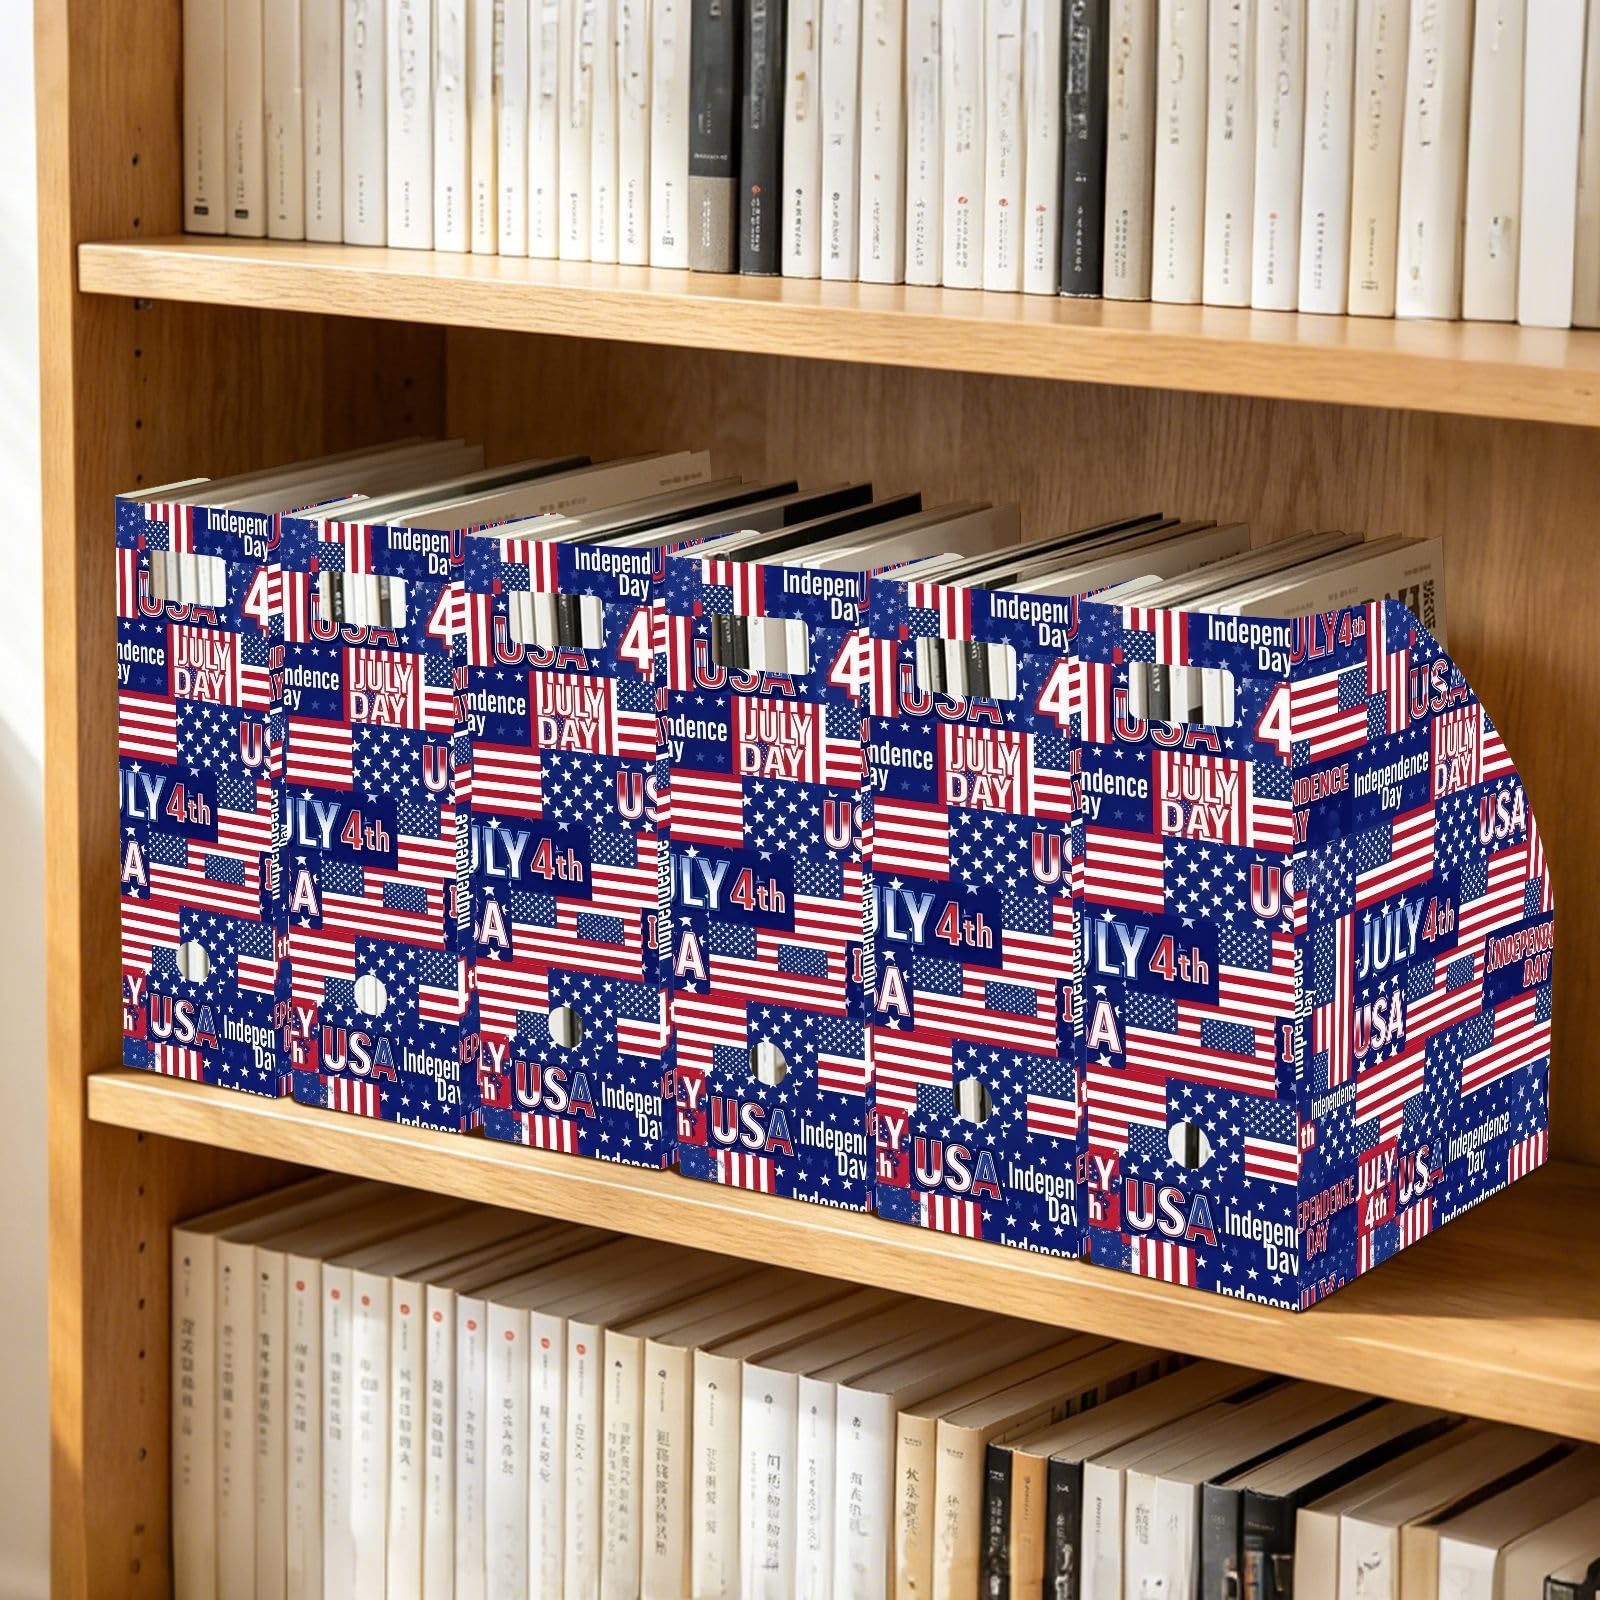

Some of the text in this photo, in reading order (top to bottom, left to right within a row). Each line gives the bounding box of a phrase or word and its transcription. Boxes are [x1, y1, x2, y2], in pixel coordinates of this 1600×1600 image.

[1339, 612, 1366, 648] 4th
[178, 636, 230, 671] JULY
[175, 669, 226, 702] DAY
[354, 657, 412, 696] JULY
[1409, 658, 1468, 720] USA
[351, 691, 406, 723] DAY
[542, 682, 603, 721] JULY
[538, 716, 598, 749] DAY
[745, 709, 811, 750] JULY
[1438, 716, 1476, 760] JULY
[740, 742, 804, 778] DAY
[951, 736, 1020, 776] JULY
[1354, 751, 1429, 798] Independence
[1434, 756, 1473, 792] DAY
[120, 769, 210, 825] LY 4th
[946, 770, 1013, 807] DAY
[1167, 764, 1238, 805] JULY
[1381, 784, 1402, 811] Day
[341, 810, 390, 852] 4th
[1162, 799, 1233, 839] DAY
[1479, 786, 1527, 845] USA
[531, 838, 583, 882] 4th
[730, 868, 785, 913] 4th
[935, 901, 992, 950] 4th
[1357, 896, 1454, 982] JULY 4th
[1149, 934, 1209, 985] 4th
[1523, 951, 1552, 988] DAY
[151, 993, 218, 1049] USA
[1354, 990, 1404, 1058] USA
[323, 1024, 397, 1082] USA
[515, 1060, 596, 1119] USA
[1311, 1082, 1356, 1120] Independence
[711, 1096, 794, 1157] USA
[1449, 1112, 1510, 1163] Independence
[914, 1137, 1002, 1200] USA
[1356, 1150, 1395, 1202] JULY
[1398, 1138, 1444, 1204] USA
[1125, 1177, 1217, 1247] USA
[1364, 1197, 1388, 1229] 4th
[1306, 1219, 1330, 1262] DAY
